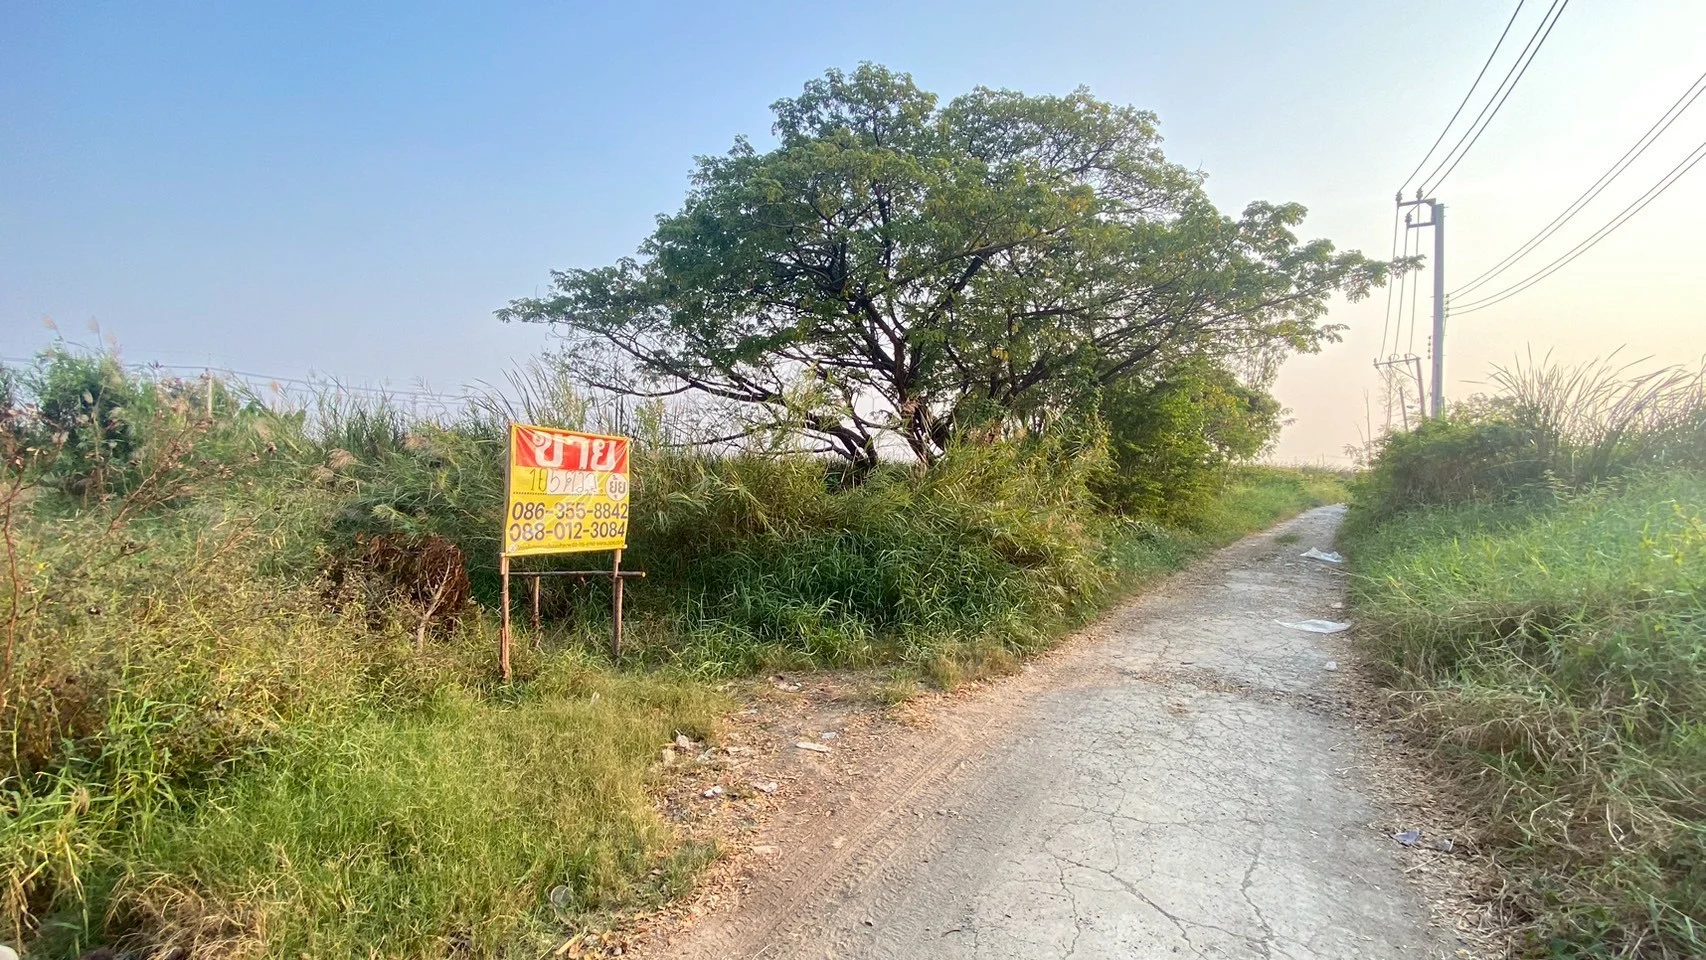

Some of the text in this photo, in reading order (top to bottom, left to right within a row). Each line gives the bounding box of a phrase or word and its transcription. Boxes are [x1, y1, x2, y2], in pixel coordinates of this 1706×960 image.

[532, 430, 617, 471] ขาย
[512, 501, 628, 521] 086-355-8842
[509, 521, 625, 542] 088-012-3084
